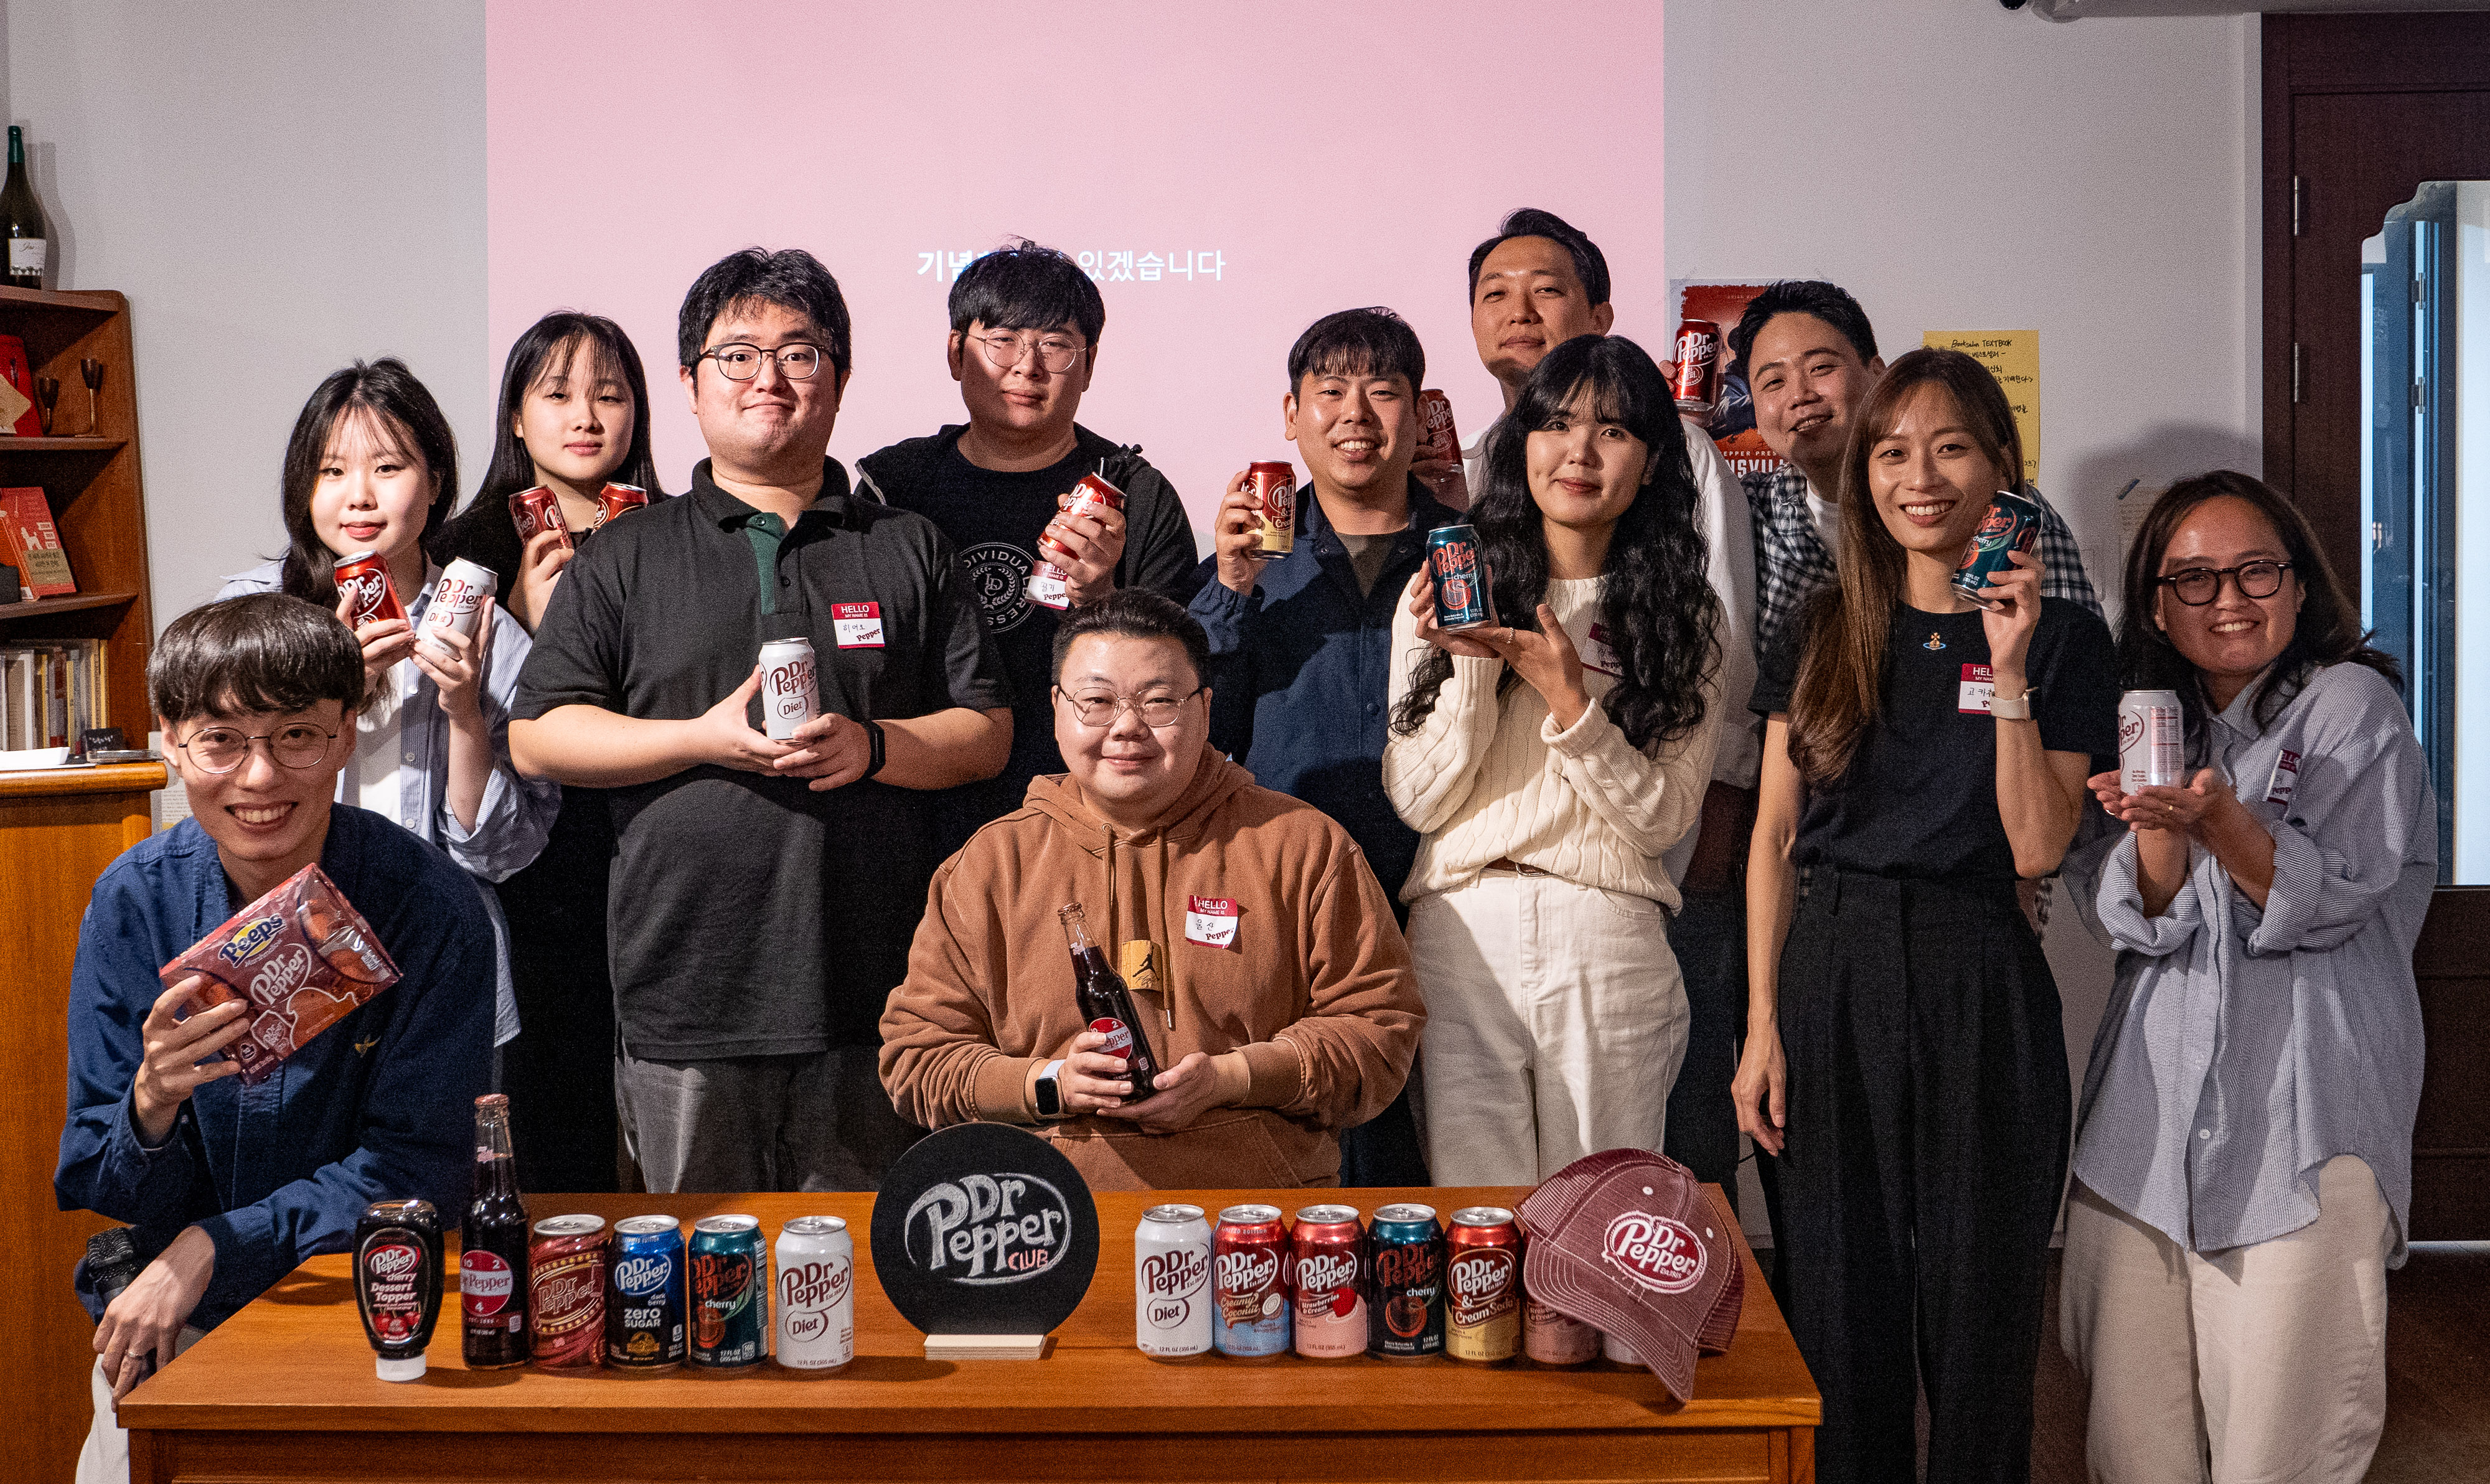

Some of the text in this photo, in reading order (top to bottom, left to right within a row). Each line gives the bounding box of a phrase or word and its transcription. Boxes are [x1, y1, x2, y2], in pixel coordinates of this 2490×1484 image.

[1078, 250, 1226, 283] 있겠습니다
[1691, 332, 1709, 348] Dr
[1431, 400, 1445, 415] Dr
[1427, 408, 1452, 430] eppe
[1973, 535, 1991, 546] cherry
[1446, 542, 1466, 559] Dr
[1454, 573, 1475, 581] cherry
[434, 579, 482, 608] Pepper
[453, 579, 474, 593] Dr
[429, 612, 446, 622] Diet
[841, 605, 870, 614] HELLO
[857, 628, 881, 642] Pepper
[787, 660, 808, 677] Dr
[1973, 667, 1993, 676] HEL
[784, 701, 802, 715] Diet
[1198, 900, 1228, 909] HELLO
[218, 913, 284, 965] Peeps
[1206, 928, 1235, 941] Pepper
[262, 954, 286, 982] Dr
[250, 949, 304, 1005] Pepper
[1112, 1021, 1119, 1029] 2
[1104, 1031, 1129, 1048] epper
[959, 1175, 1026, 1224] Dr
[905, 1183, 1062, 1276] Pepper
[1612, 1219, 1696, 1274] Pepper
[1650, 1225, 1686, 1252] Dr
[371, 1252, 412, 1274] Pepper
[385, 1249, 402, 1260] Dr
[1008, 1249, 1048, 1270] CLUB
[1165, 1250, 1194, 1274] Dr
[1230, 1252, 1257, 1274] Dr
[1402, 1245, 1429, 1267] Dr
[492, 1259, 500, 1270] 2
[632, 1258, 654, 1275] Dr
[700, 1254, 727, 1277] Dr
[1315, 1254, 1339, 1275] Dr
[1470, 1259, 1495, 1279] Dr
[387, 1273, 416, 1282] cherry
[615, 1261, 667, 1291] Pepper
[804, 1262, 834, 1286] Dr
[1142, 1254, 1208, 1295] Pepper
[1214, 1254, 1274, 1293] Pepper
[1297, 1258, 1353, 1292] Pepper
[1451, 1262, 1509, 1295] Pepper
[370, 1282, 413, 1292] Dessert
[469, 1273, 510, 1292] Pepper
[552, 1277, 577, 1298] Dr
[781, 1266, 849, 1308] Pepper
[375, 1292, 416, 1302] Topper
[538, 1280, 596, 1314] Pepper
[1221, 1292, 1259, 1308] Creamy
[1302, 1293, 1339, 1308] Strawberries
[1406, 1287, 1435, 1297] cherry
[476, 1302, 483, 1312] 4
[705, 1300, 736, 1310] cherry
[1308, 1305, 1327, 1314] Cream
[1462, 1295, 1473, 1308] &
[624, 1308, 661, 1320] zero
[1154, 1306, 1180, 1322] Diet
[1223, 1303, 1260, 1318] Coconut
[1455, 1297, 1514, 1324] Cream Soda
[624, 1319, 661, 1328] SUGAR
[792, 1318, 819, 1335] Diet
